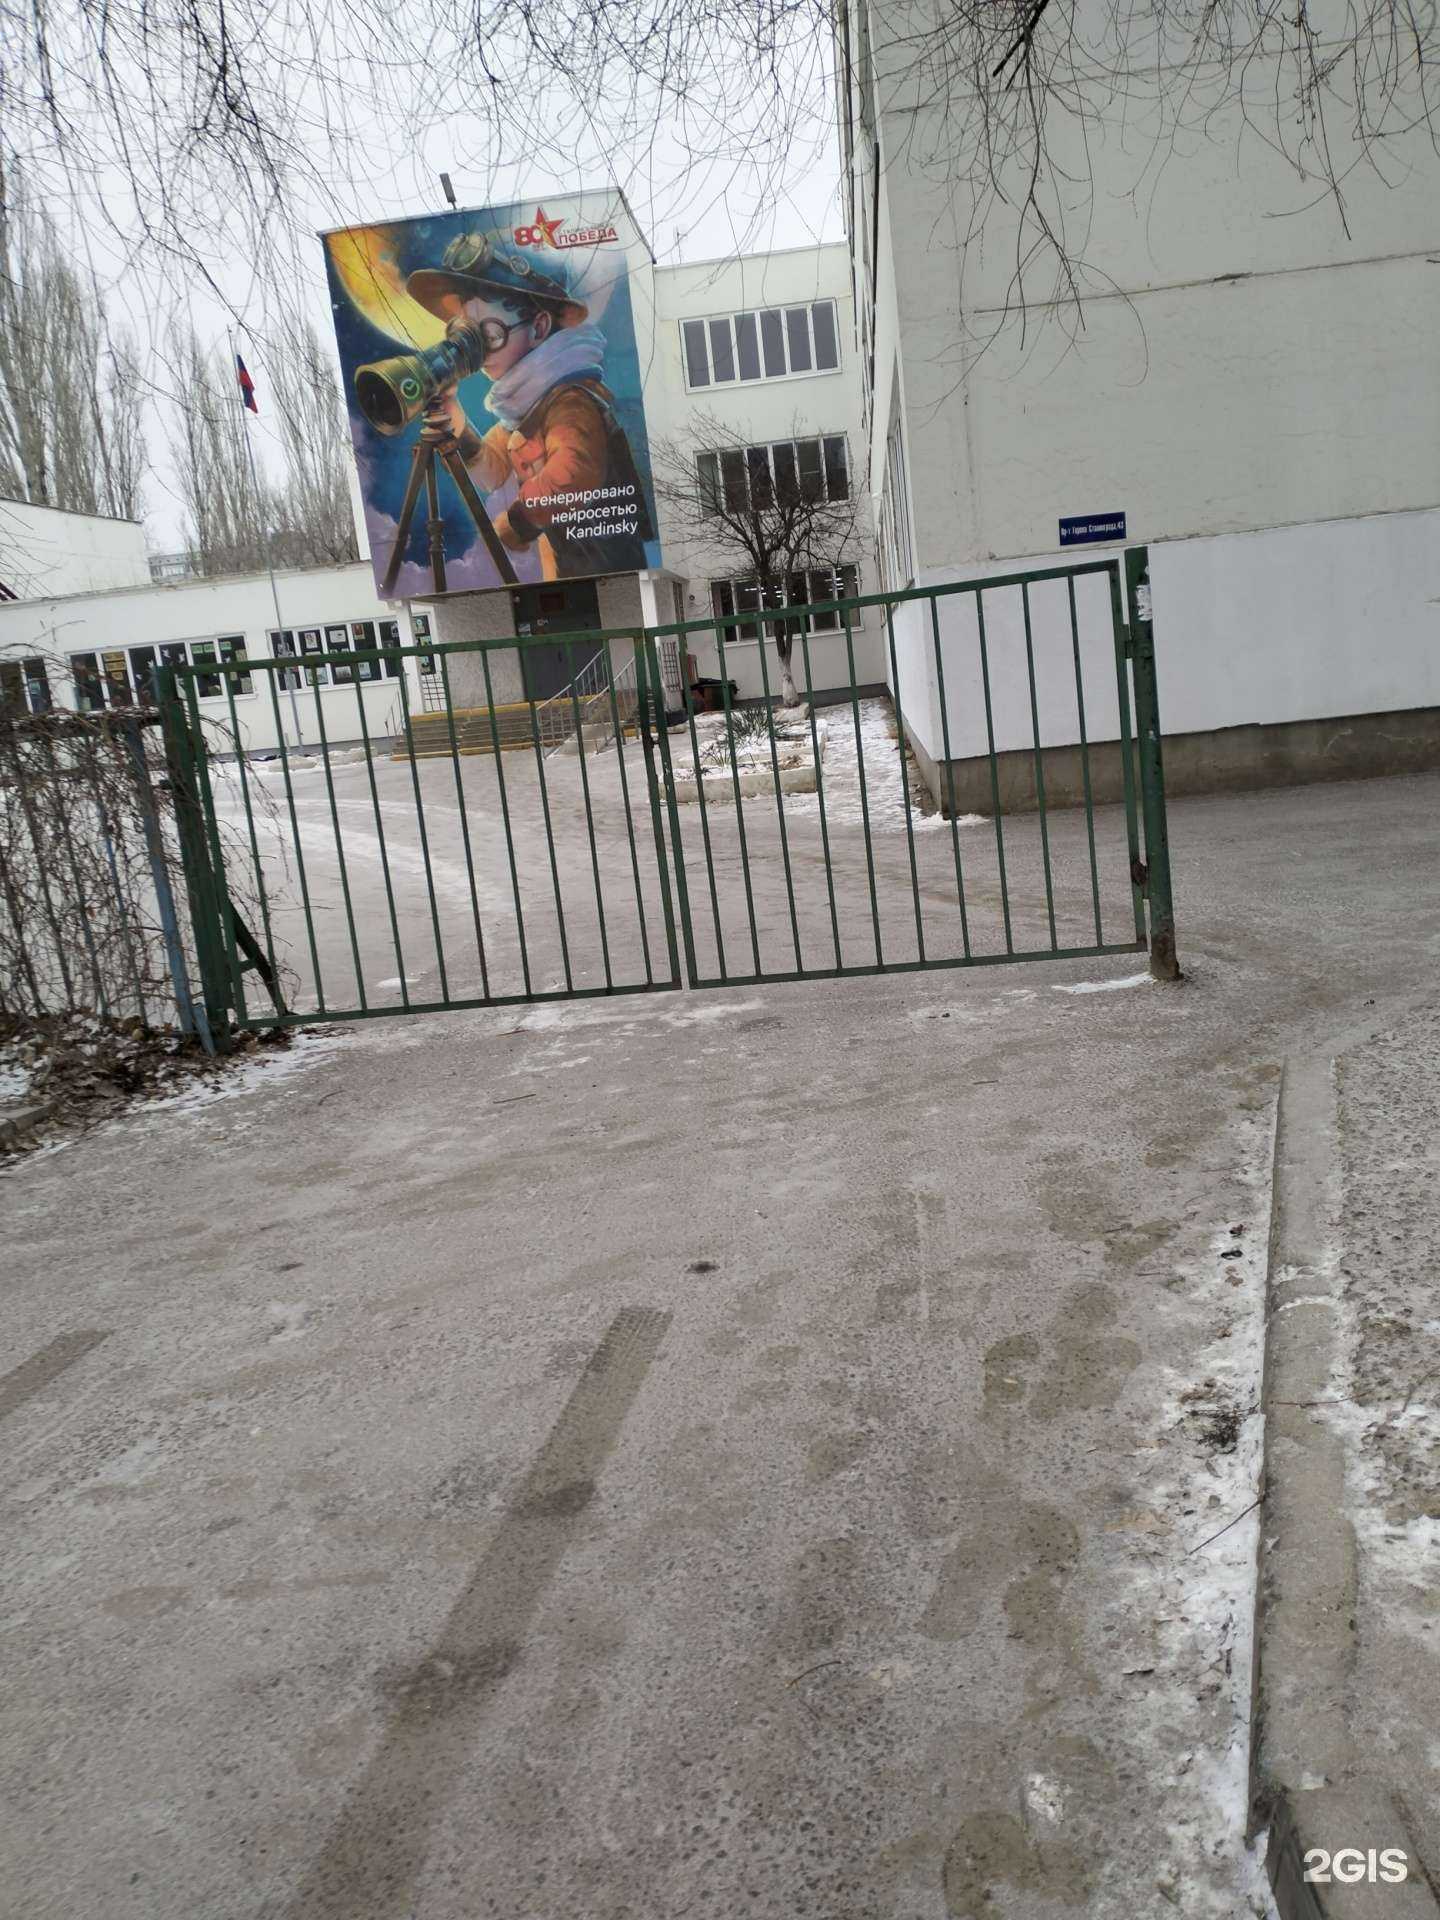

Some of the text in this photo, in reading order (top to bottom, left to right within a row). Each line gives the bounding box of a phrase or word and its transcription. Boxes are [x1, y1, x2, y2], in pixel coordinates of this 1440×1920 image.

[559, 227, 617, 244] ПОБЕДА
[525, 485, 635, 508] сгенерировано
[551, 503, 638, 524] нейросетью
[566, 519, 639, 540] Kandinsky
